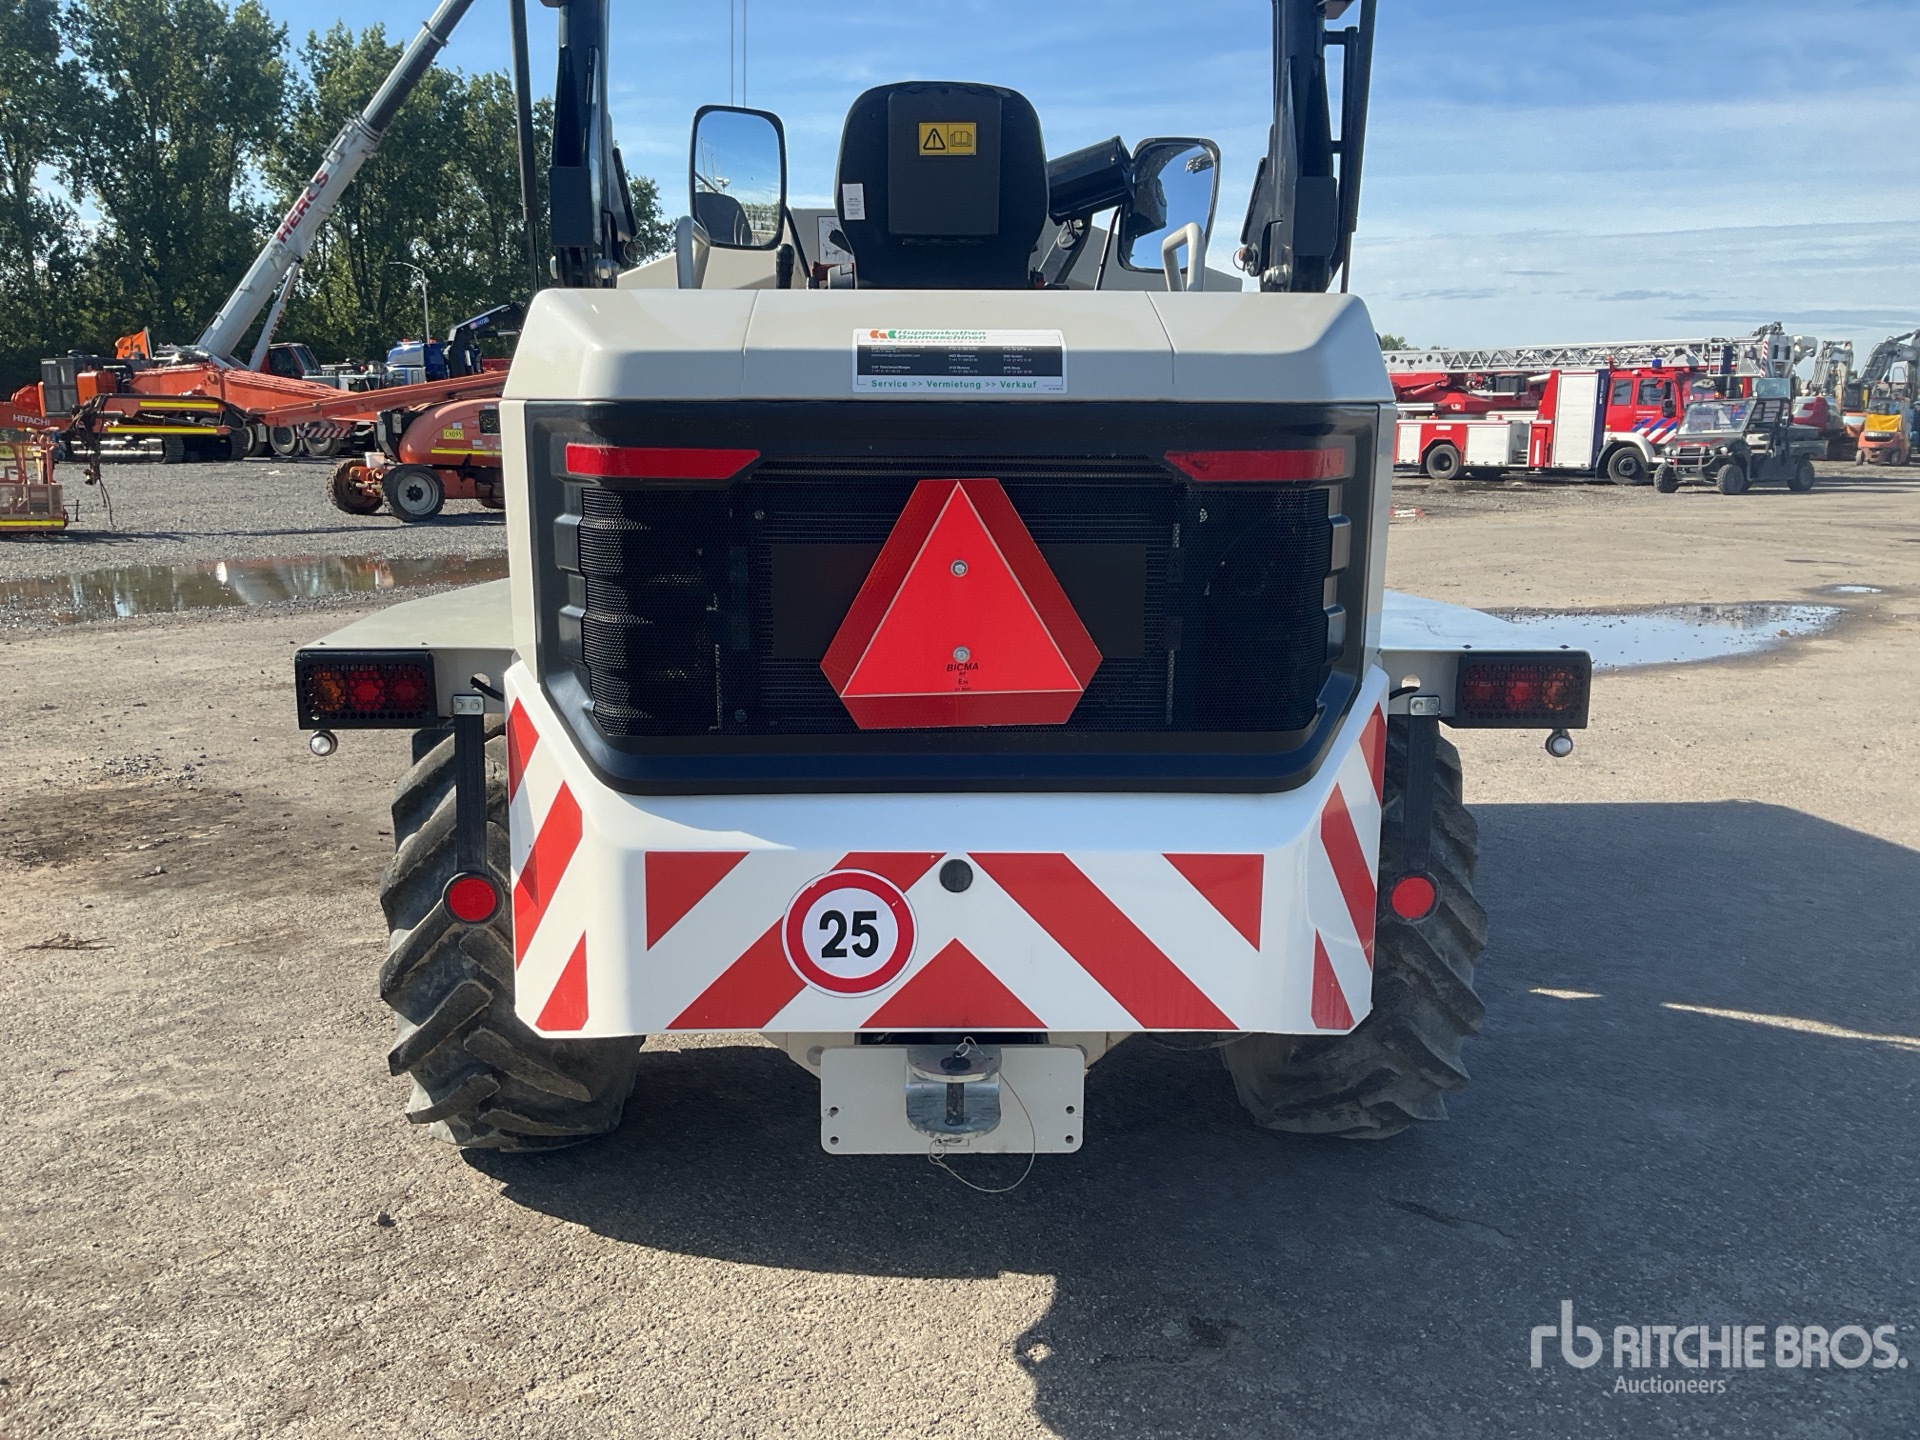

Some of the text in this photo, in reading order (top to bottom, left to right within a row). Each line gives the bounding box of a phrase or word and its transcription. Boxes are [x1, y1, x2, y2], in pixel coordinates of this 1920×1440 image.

[871, 379, 908, 388] Service
[926, 380, 981, 389] Vermietung
[1000, 380, 1037, 388] Verkauf
[12, 414, 51, 426] HITACHI
[946, 663, 979, 672] BICMA
[819, 909, 880, 958] 25
